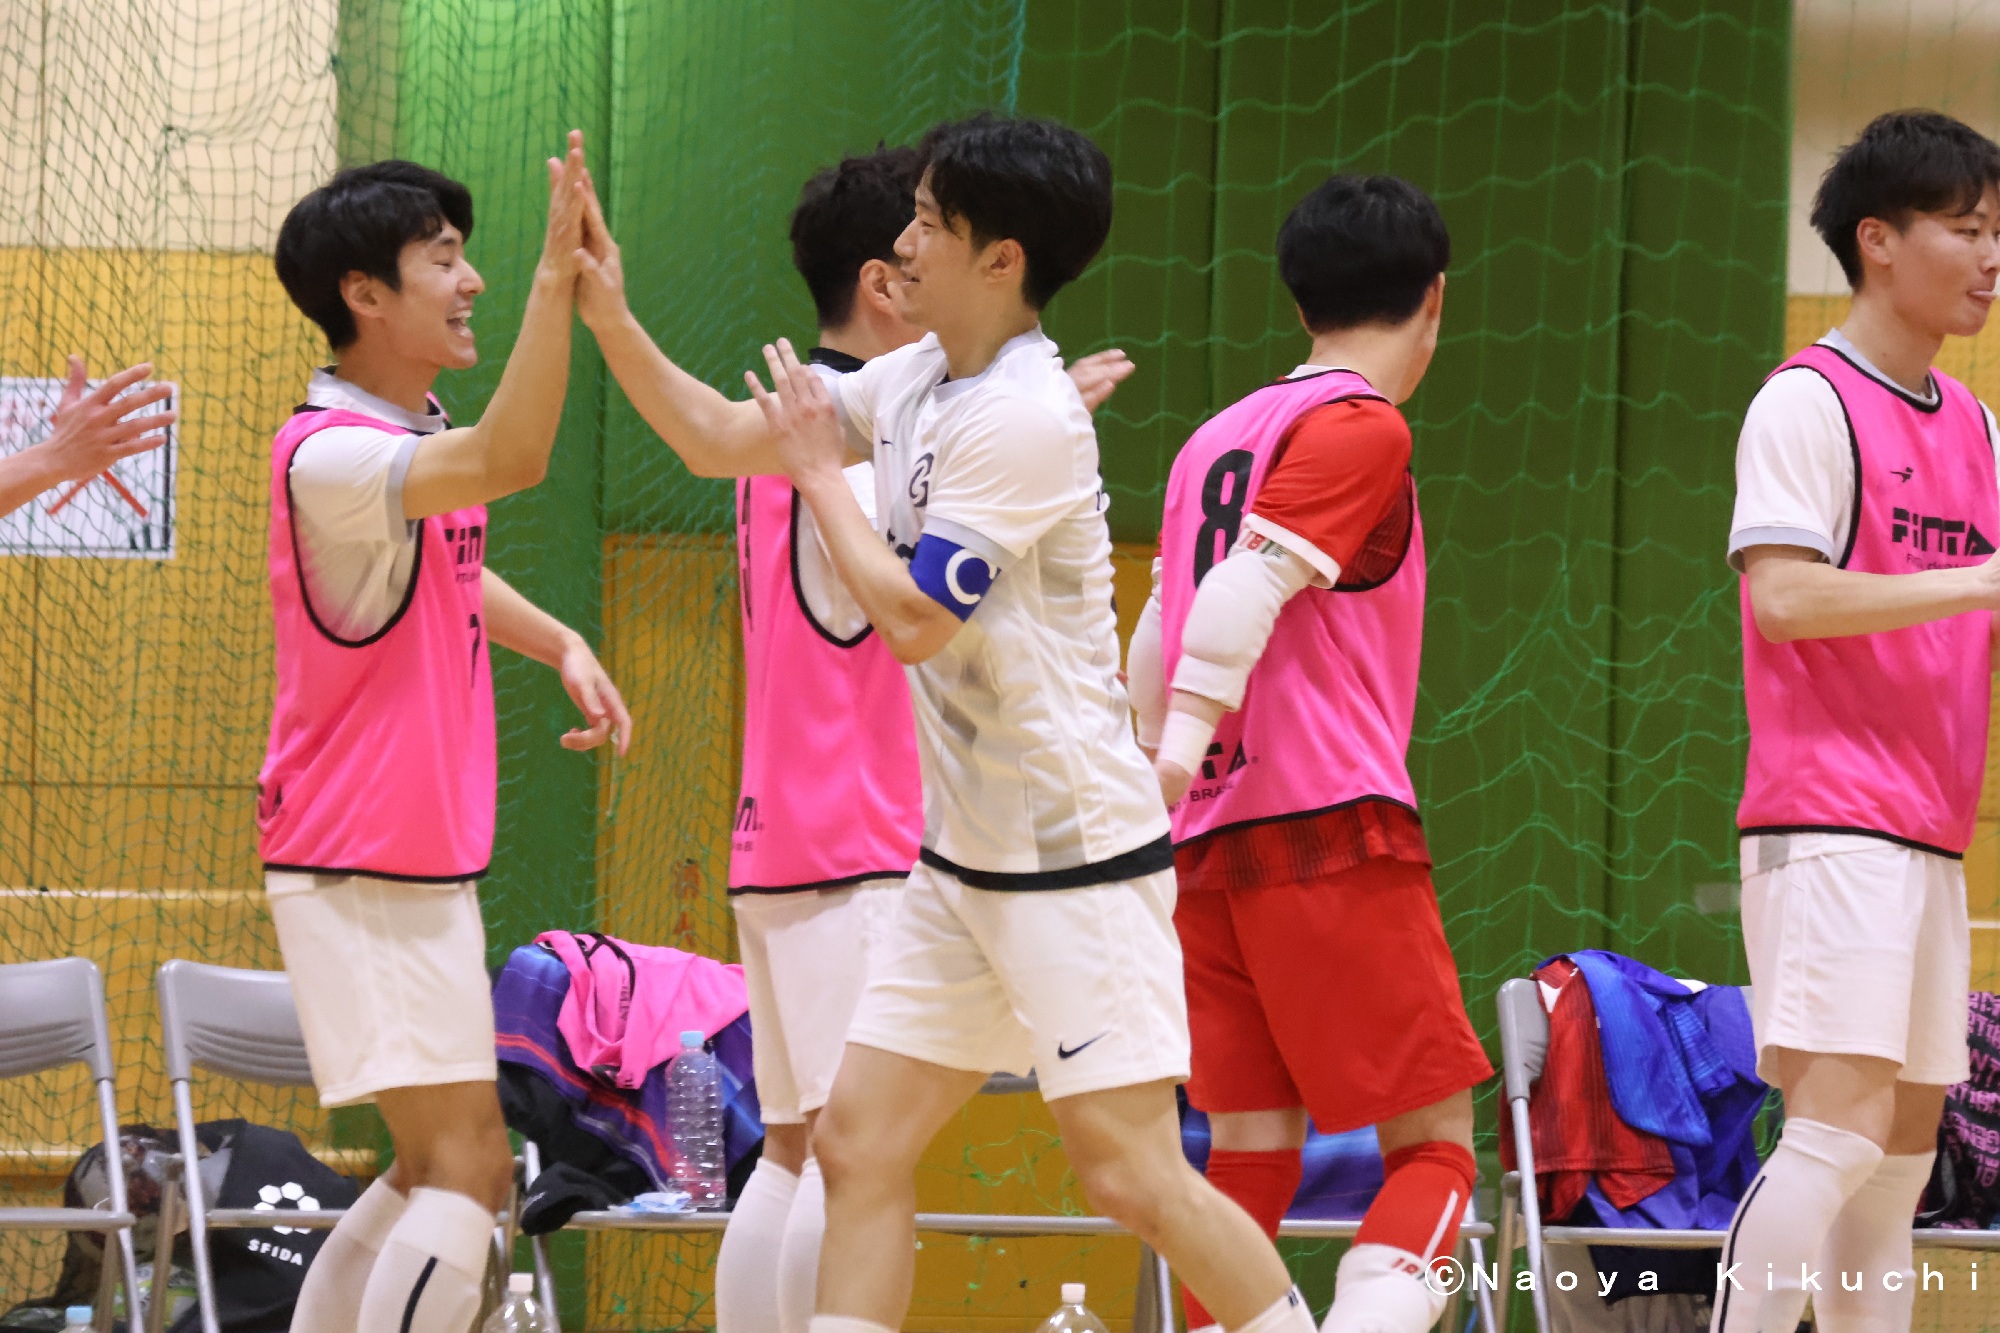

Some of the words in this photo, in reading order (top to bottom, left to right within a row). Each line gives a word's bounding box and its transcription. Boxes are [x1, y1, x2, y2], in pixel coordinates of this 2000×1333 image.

[1194, 449, 1255, 590] 8
[945, 548, 998, 605] C
[247, 1238, 303, 1267] SFIDA
